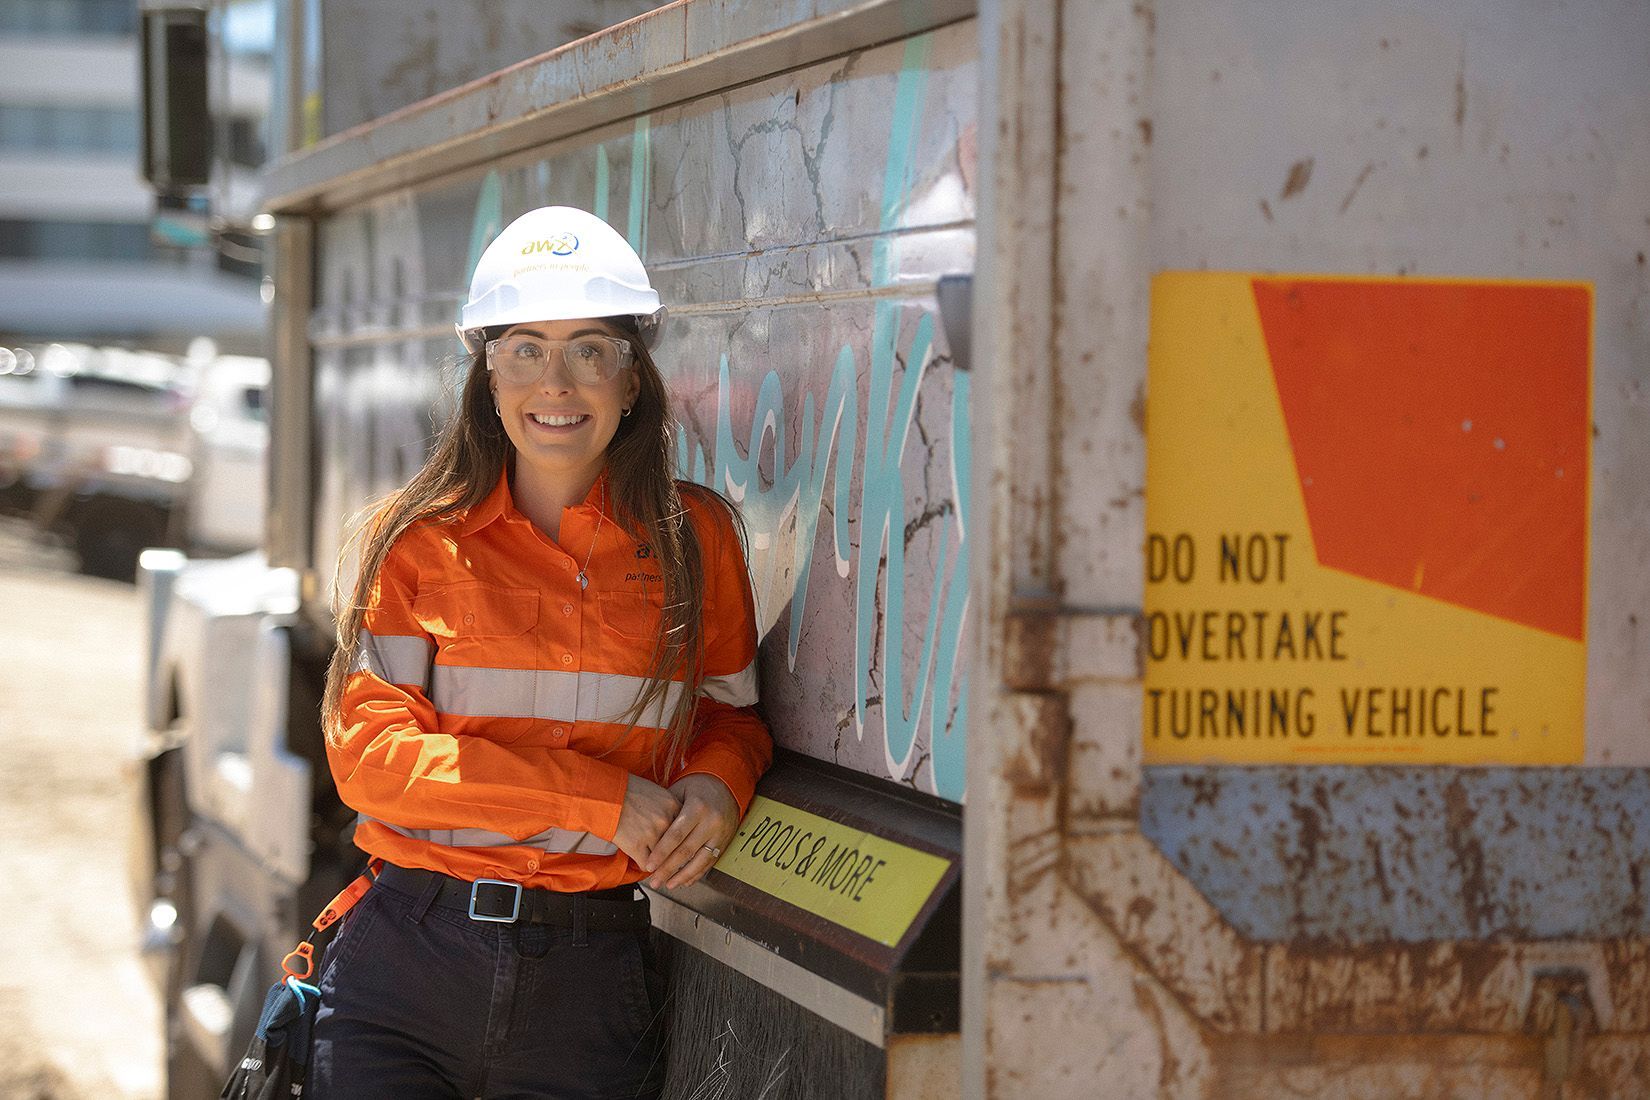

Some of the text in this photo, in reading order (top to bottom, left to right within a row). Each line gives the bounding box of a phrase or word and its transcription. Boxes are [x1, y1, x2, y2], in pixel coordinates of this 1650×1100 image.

[1148, 533, 1290, 583] DO NOT
[1147, 610, 1349, 661] OVERTAKE
[1147, 687, 1499, 739] TURNING VEHICLE
[740, 816, 813, 871] POOLS
[795, 836, 827, 878] &
[810, 844, 886, 902] MORE
